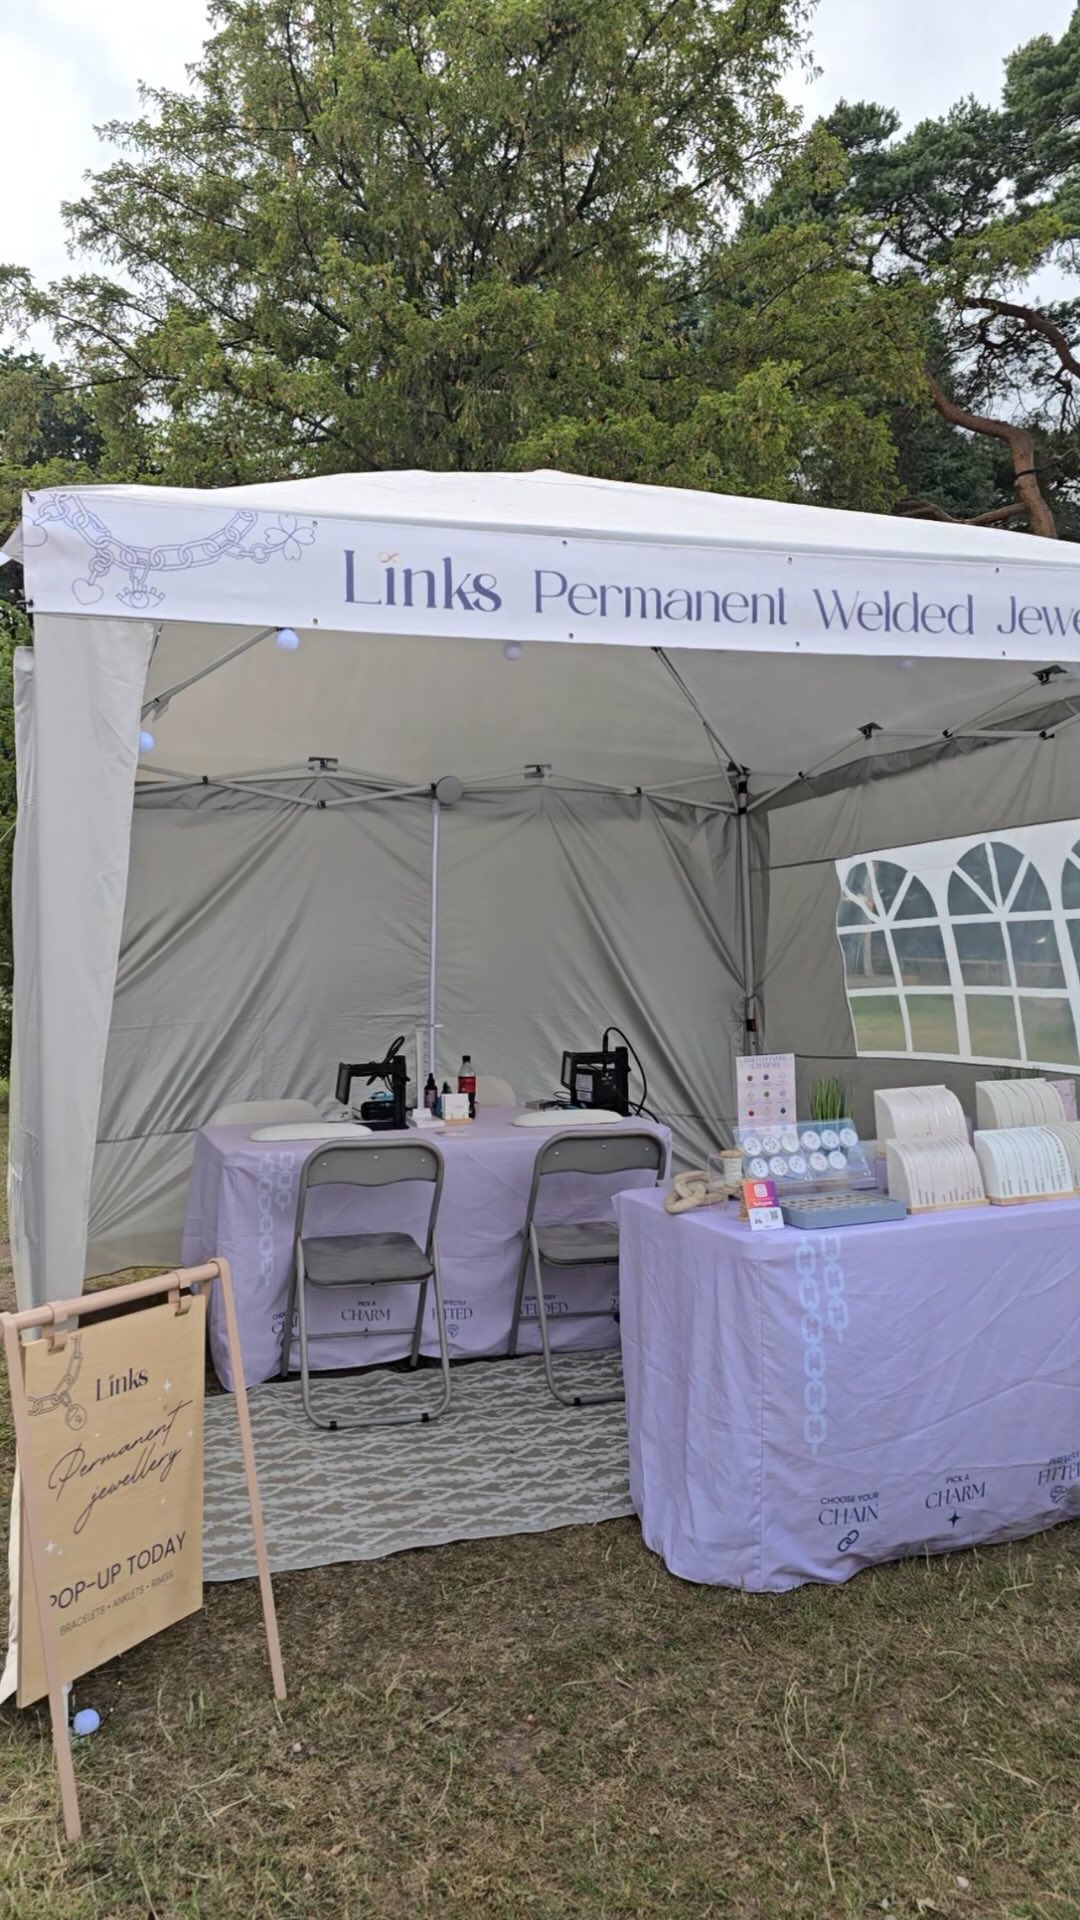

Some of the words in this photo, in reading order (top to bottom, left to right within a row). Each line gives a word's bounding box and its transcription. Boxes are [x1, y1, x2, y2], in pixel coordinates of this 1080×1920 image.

[343, 549, 502, 613] Links
[534, 569, 789, 625] Permanent
[812, 588, 975, 635] Welded
[341, 1308, 391, 1322] CHARM
[96, 1368, 149, 1401] Links
[48, 1399, 193, 1502] Permanent
[73, 1442, 183, 1534] jewellery
[925, 1481, 986, 1509] CHARM
[946, 1475, 963, 1485] PICK
[963, 1474, 970, 1482] A
[818, 1503, 880, 1527] CHAIN
[820, 1494, 857, 1506] CHOOSE
[857, 1491, 880, 1502] YOUR
[127, 1530, 186, 1576] TODAY
[59, 1604, 107, 1637] BRACELETS
[112, 1584, 145, 1608] ANKLETS
